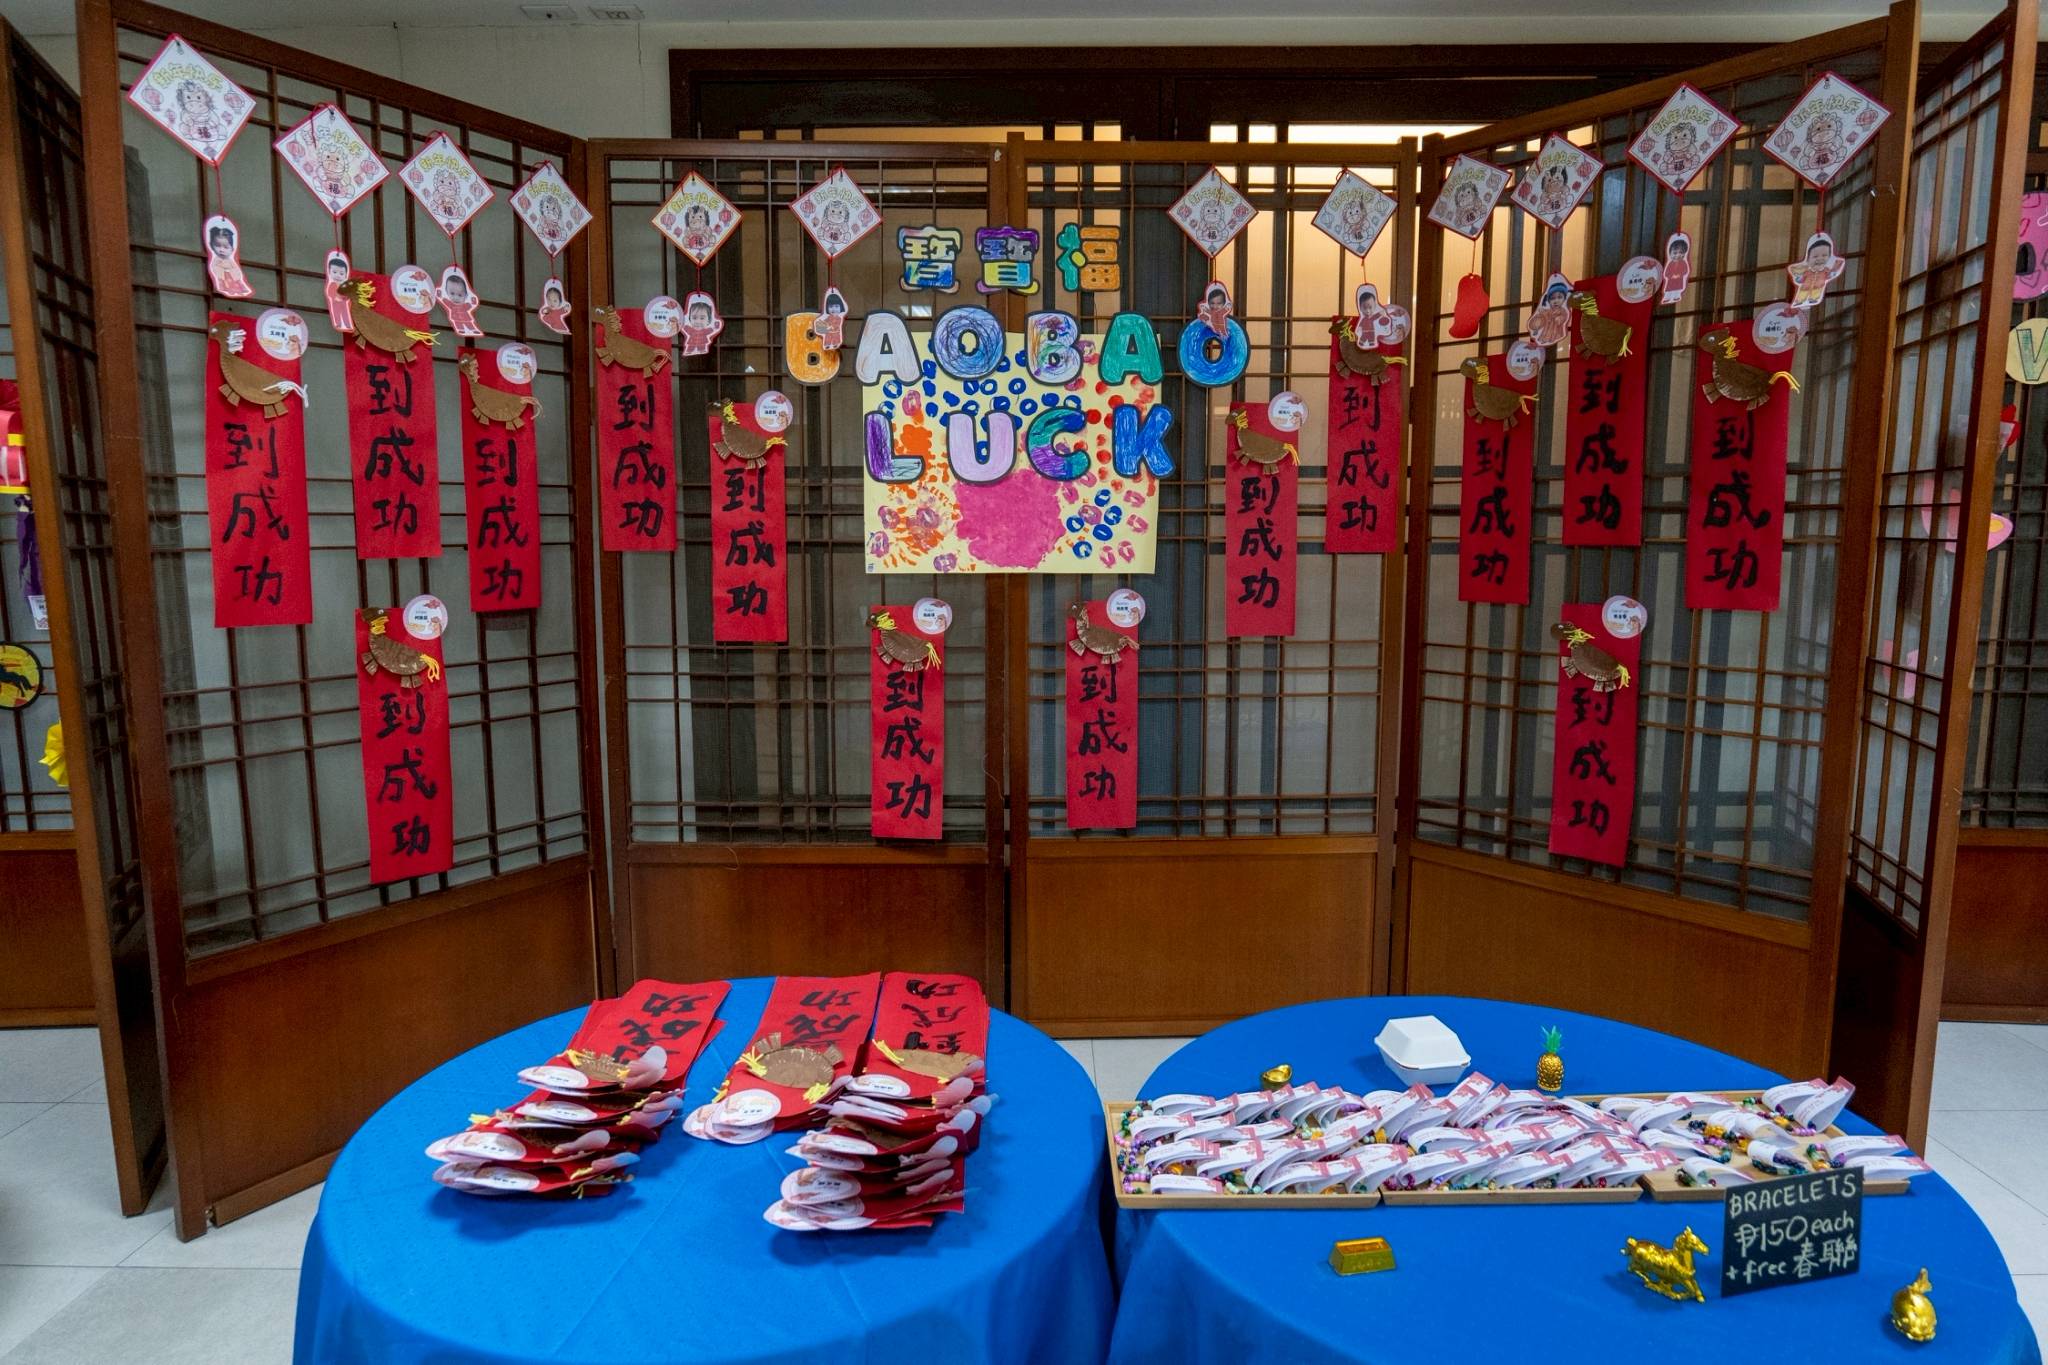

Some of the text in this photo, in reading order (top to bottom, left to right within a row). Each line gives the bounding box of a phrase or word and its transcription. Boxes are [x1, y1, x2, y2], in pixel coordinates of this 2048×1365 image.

[785, 304, 1250, 387] BAOBAO
[223, 422, 289, 606] 到成功
[364, 364, 424, 535] 到成功
[612, 383, 666, 538] 到成功
[864, 404, 1175, 482] LUCK
[1337, 385, 1389, 532] 到成功
[1469, 434, 1514, 586] 到成功
[1575, 369, 1629, 530] 到成功
[1703, 409, 1771, 590] 到成功
[474, 438, 528, 600] 到成功
[721, 468, 775, 616] 到成功
[1237, 476, 1282, 609] 到成功
[377, 691, 437, 856] 到成功
[881, 670, 934, 820] 到成功
[1078, 664, 1128, 801] 到成功
[1568, 687, 1616, 837] 到成功
[1729, 1173, 1857, 1219] BRACELETS
[1811, 1210, 1854, 1236] each
[1743, 1260, 1787, 1284] free
